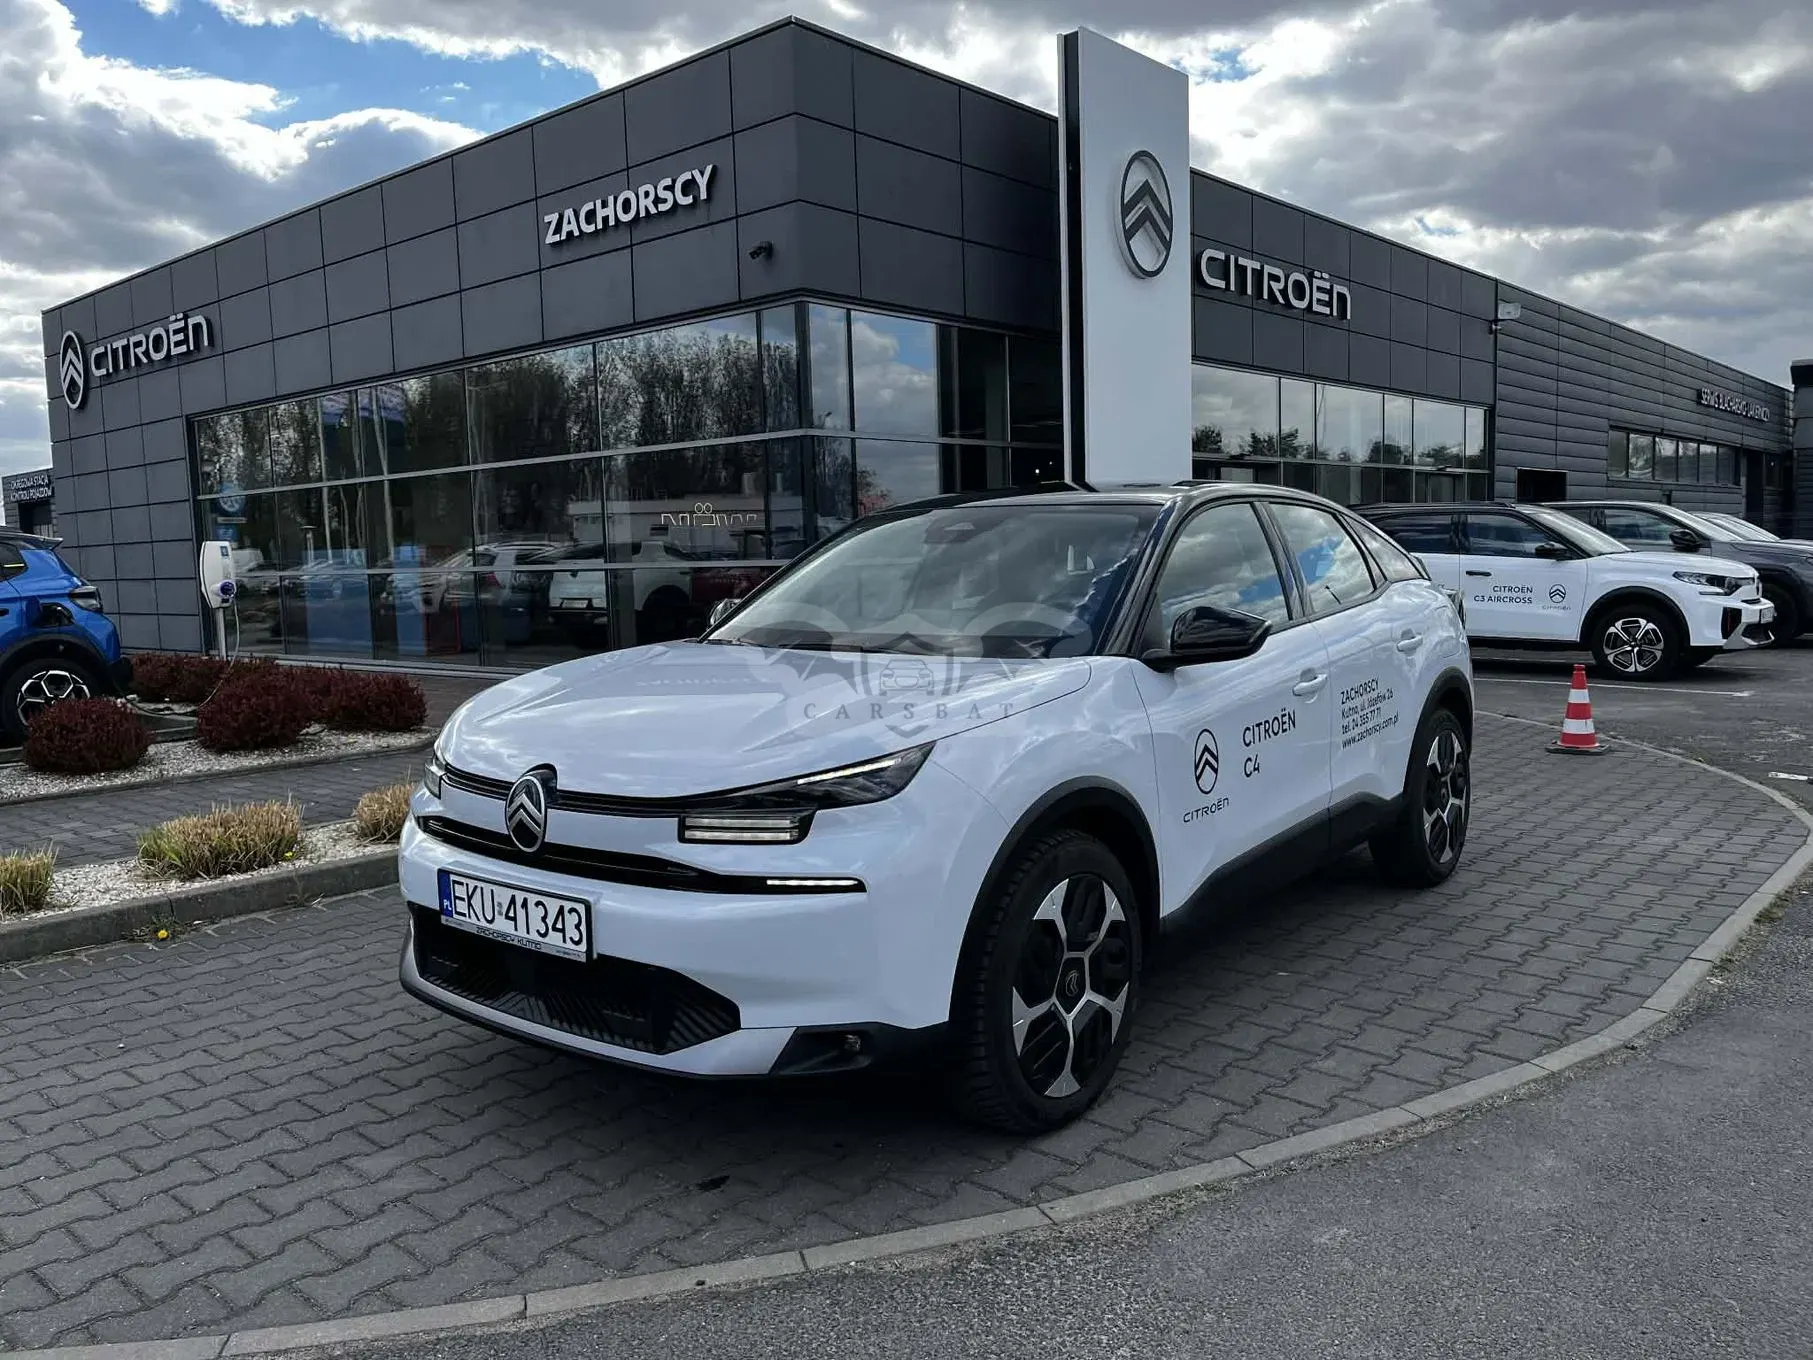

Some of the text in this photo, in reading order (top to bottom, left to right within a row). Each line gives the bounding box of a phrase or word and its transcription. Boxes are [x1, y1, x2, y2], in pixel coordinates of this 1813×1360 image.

[543, 164, 714, 245] ZACHORSCY
[1200, 248, 1351, 320] CITROËN
[90, 312, 209, 377] CITROËN
[1473, 595, 1533, 605] C3 AIRCROSS
[1492, 584, 1534, 594] CITROËN
[1340, 678, 1379, 705] ZACHORSCY
[1342, 705, 1360, 720] Kutno,
[1242, 707, 1296, 748] CITROËN
[1341, 720, 1351, 735] tel.
[1243, 753, 1261, 779] C4
[1183, 797, 1230, 824] CITROËN
[443, 900, 452, 911] PL
[451, 879, 583, 946] EKU 41343
[475, 925, 542, 950] ZACHORSCY KUTNO
